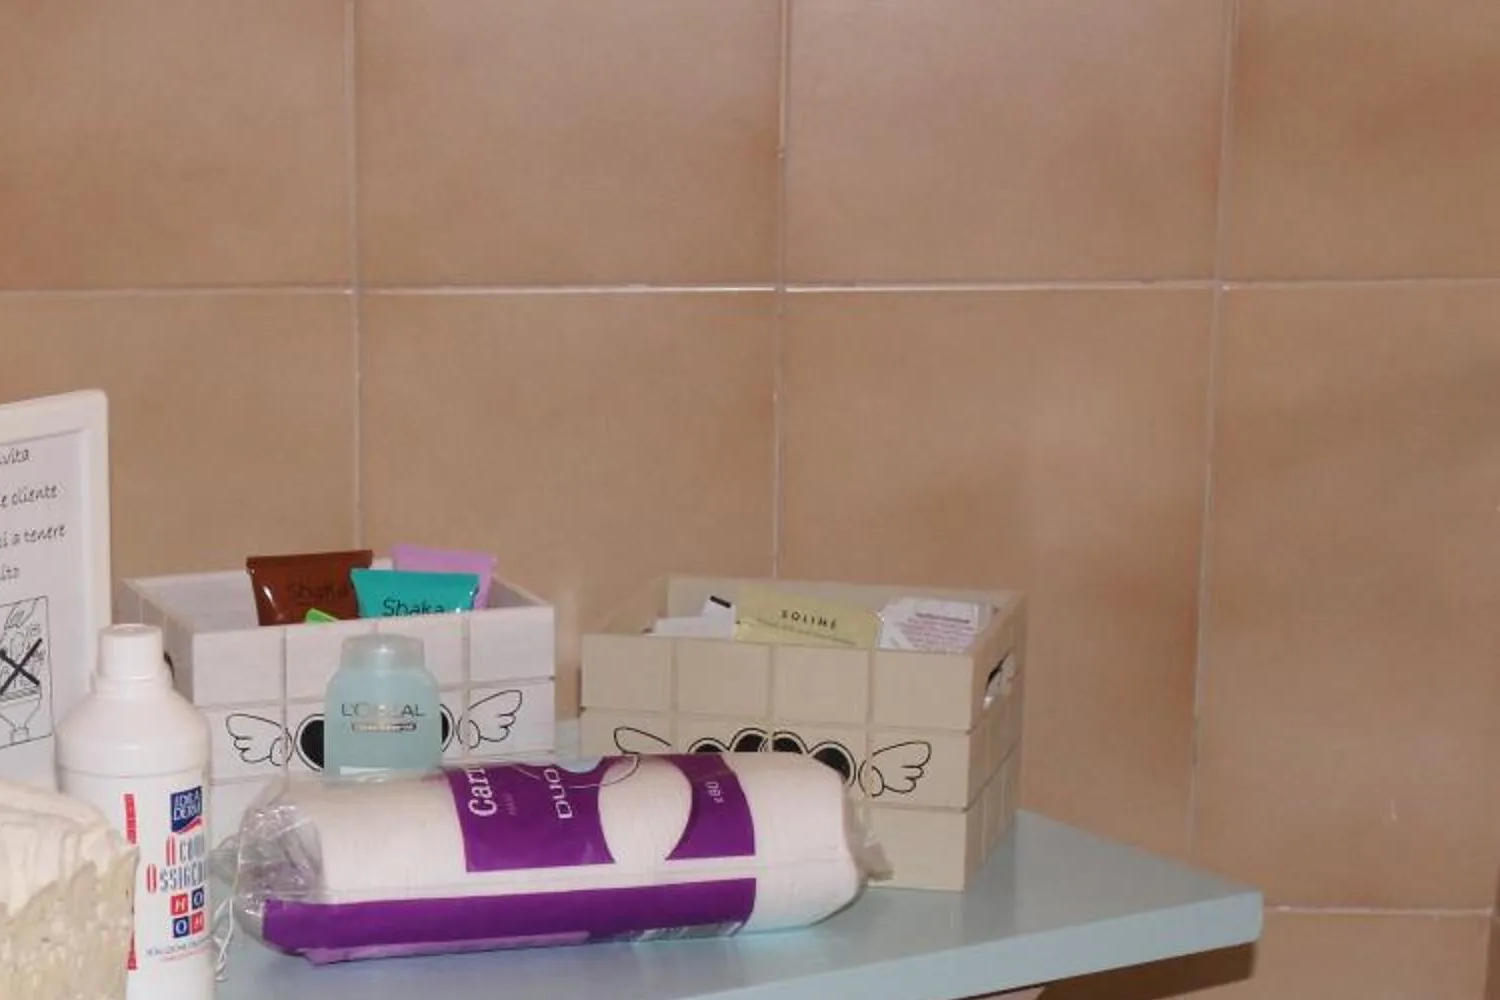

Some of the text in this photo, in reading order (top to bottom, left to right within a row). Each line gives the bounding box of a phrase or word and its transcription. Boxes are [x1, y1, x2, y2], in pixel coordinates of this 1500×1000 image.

[11, 485, 58, 505] cliente
[24, 525, 66, 543] tenere
[382, 596, 445, 616] Shaka
[543, 767, 573, 819] DUO
